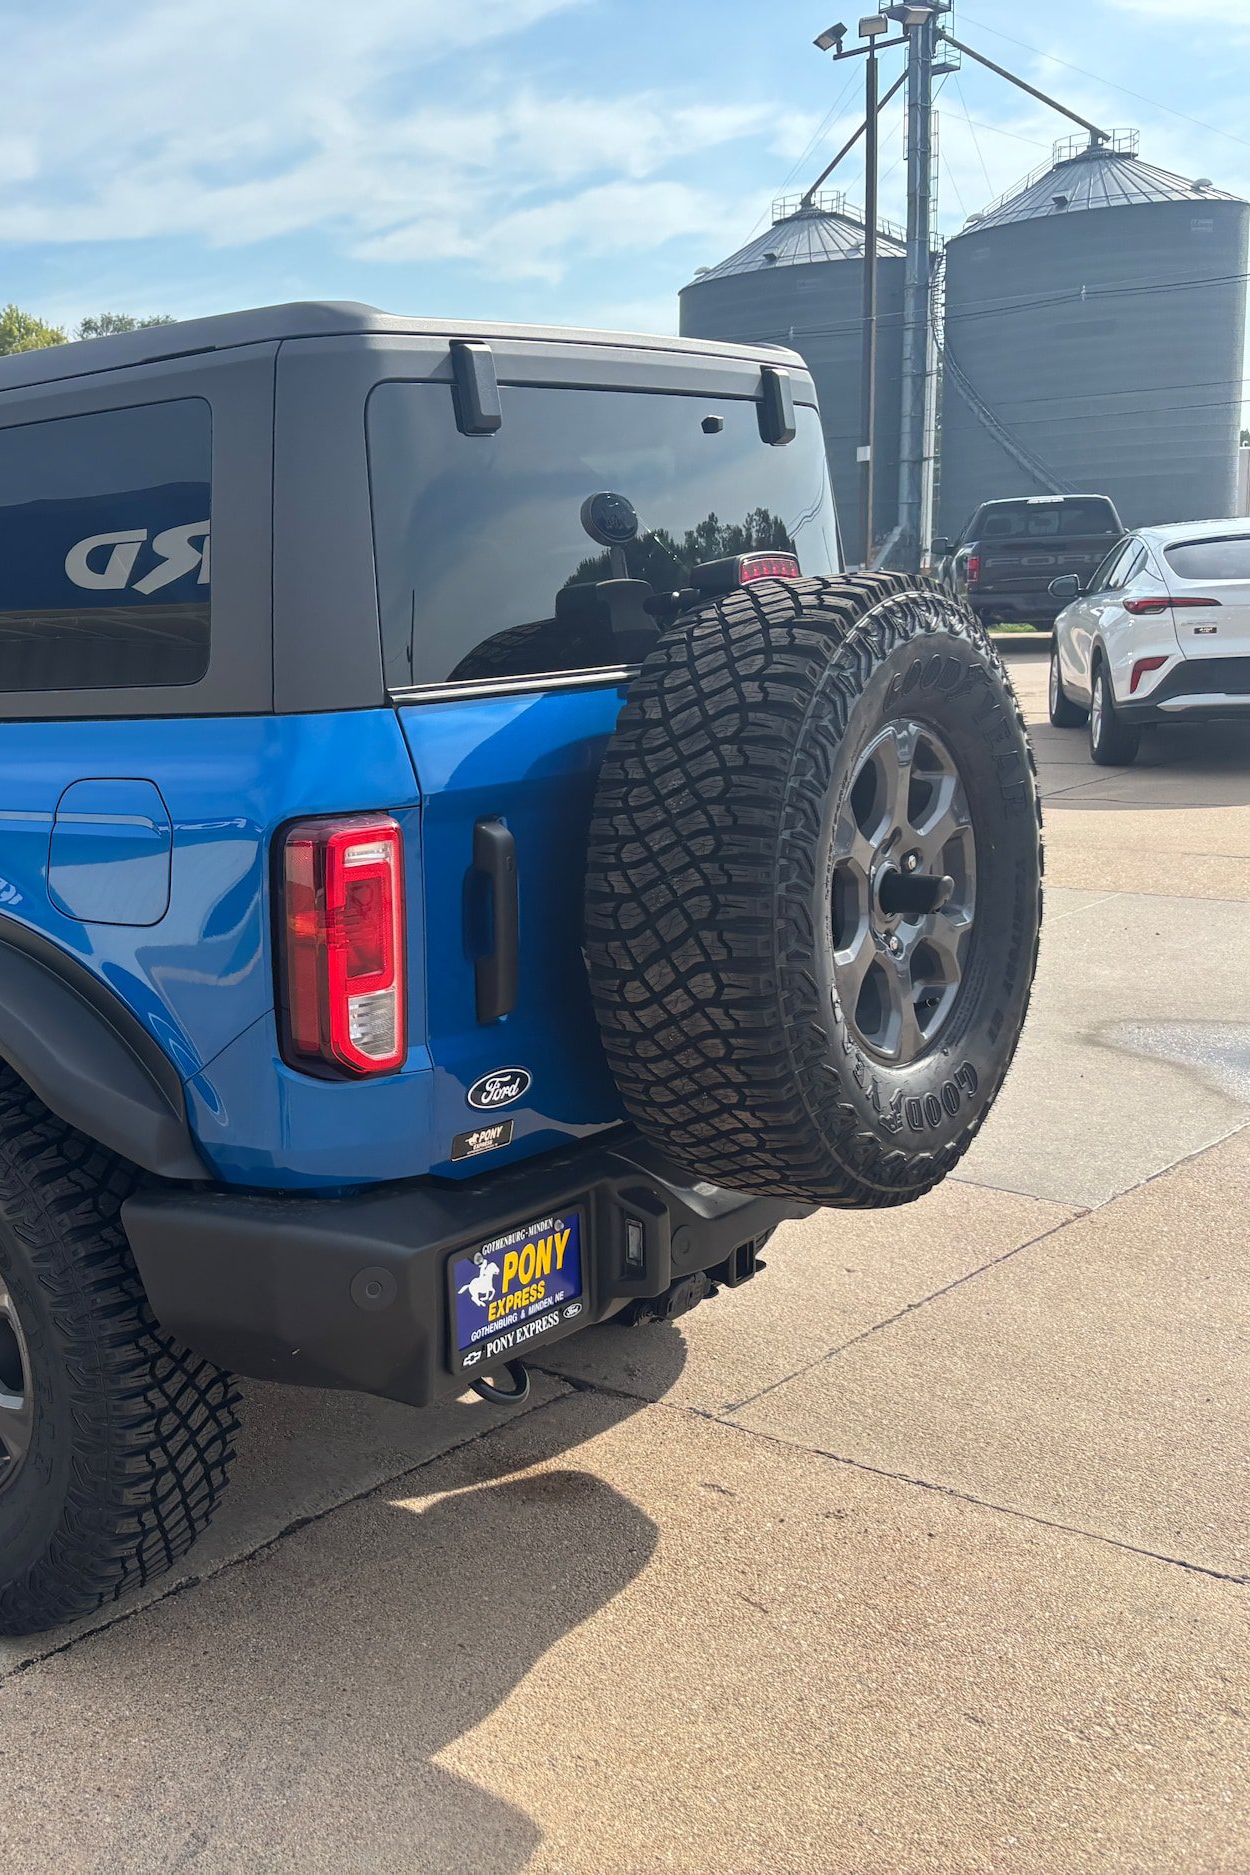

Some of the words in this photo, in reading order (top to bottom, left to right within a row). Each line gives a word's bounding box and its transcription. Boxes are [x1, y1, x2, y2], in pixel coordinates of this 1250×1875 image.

[985, 553, 1105, 568] FOR
[479, 1073, 524, 1105] Ford
[479, 1126, 503, 1143] PONY
[482, 1217, 554, 1256] GOTHENBURG-MINDEN
[502, 1228, 571, 1294] PONY
[470, 1312, 518, 1342] GOTHENBURG
[520, 1310, 526, 1319] &
[554, 1290, 565, 1304] NE
[488, 1280, 546, 1321] EXPRESS
[565, 1304, 580, 1316] Ford
[486, 1331, 515, 1358] PONY
[516, 1310, 560, 1344] EXPRESS
